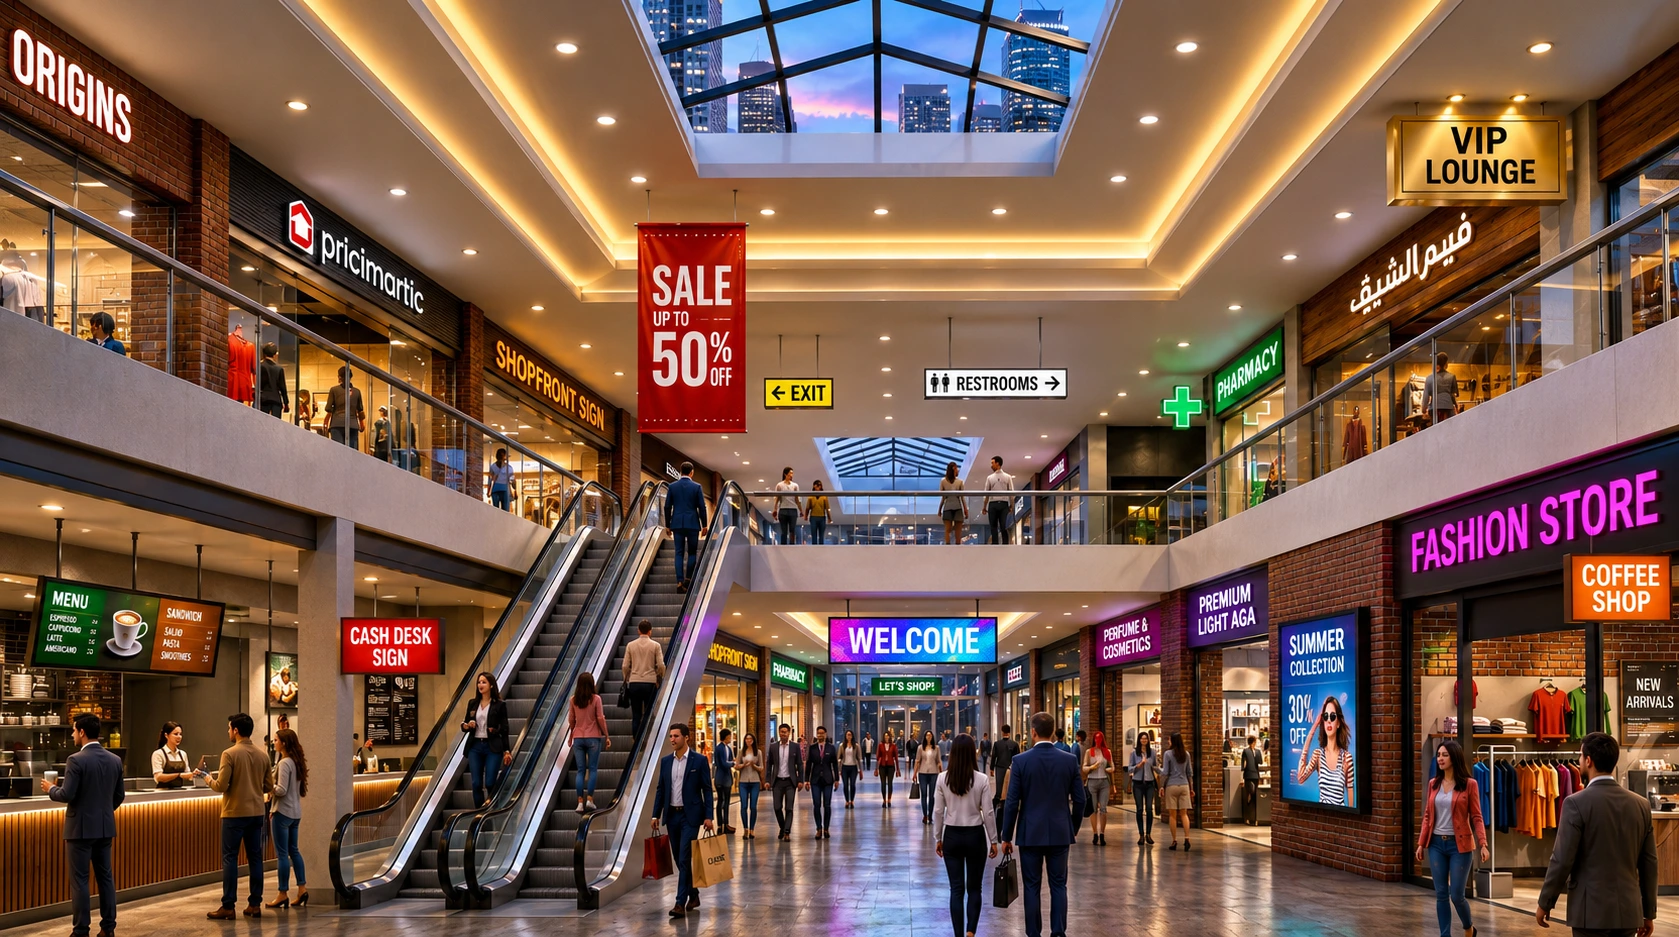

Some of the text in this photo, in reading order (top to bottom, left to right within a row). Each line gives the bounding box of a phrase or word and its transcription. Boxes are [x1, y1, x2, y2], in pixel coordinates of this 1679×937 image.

[12, 28, 132, 144] ORIGINS
[1450, 126, 1507, 154] VIP
[1426, 159, 1536, 185] LOUNGE
[321, 229, 425, 315] pricimartic
[652, 265, 732, 306] SALE
[653, 311, 689, 327] UP TO
[652, 331, 732, 387] 50% OFF
[1217, 341, 1278, 402] PHARMACY
[496, 340, 604, 431] SHOPFRONT SIGN
[791, 384, 826, 402] EXIT
[957, 376, 1038, 392] RESTROOMS
[1412, 469, 1659, 573] FASHION STORE
[1582, 564, 1660, 587] COFFEE
[52, 590, 89, 609] MENU
[1199, 583, 1251, 614] PREMIUM
[1592, 590, 1651, 613] SHOP
[166, 607, 203, 622] SANDWICH
[1198, 606, 1256, 636] LIGHT AGA
[350, 626, 432, 646] CASH DESK
[848, 627, 980, 655] WELCOME
[1103, 617, 1149, 643] PERFUME &
[1289, 627, 1344, 656] SUMMER
[372, 649, 408, 667] SIGN
[1102, 635, 1151, 660] COSMETICS
[1290, 656, 1344, 677] COLLECTION
[879, 681, 935, 691] LET'S SHOP!
[1636, 678, 1661, 692] NEW
[1626, 695, 1674, 709] ARRIVALS
[1289, 727, 1307, 745] OFF
